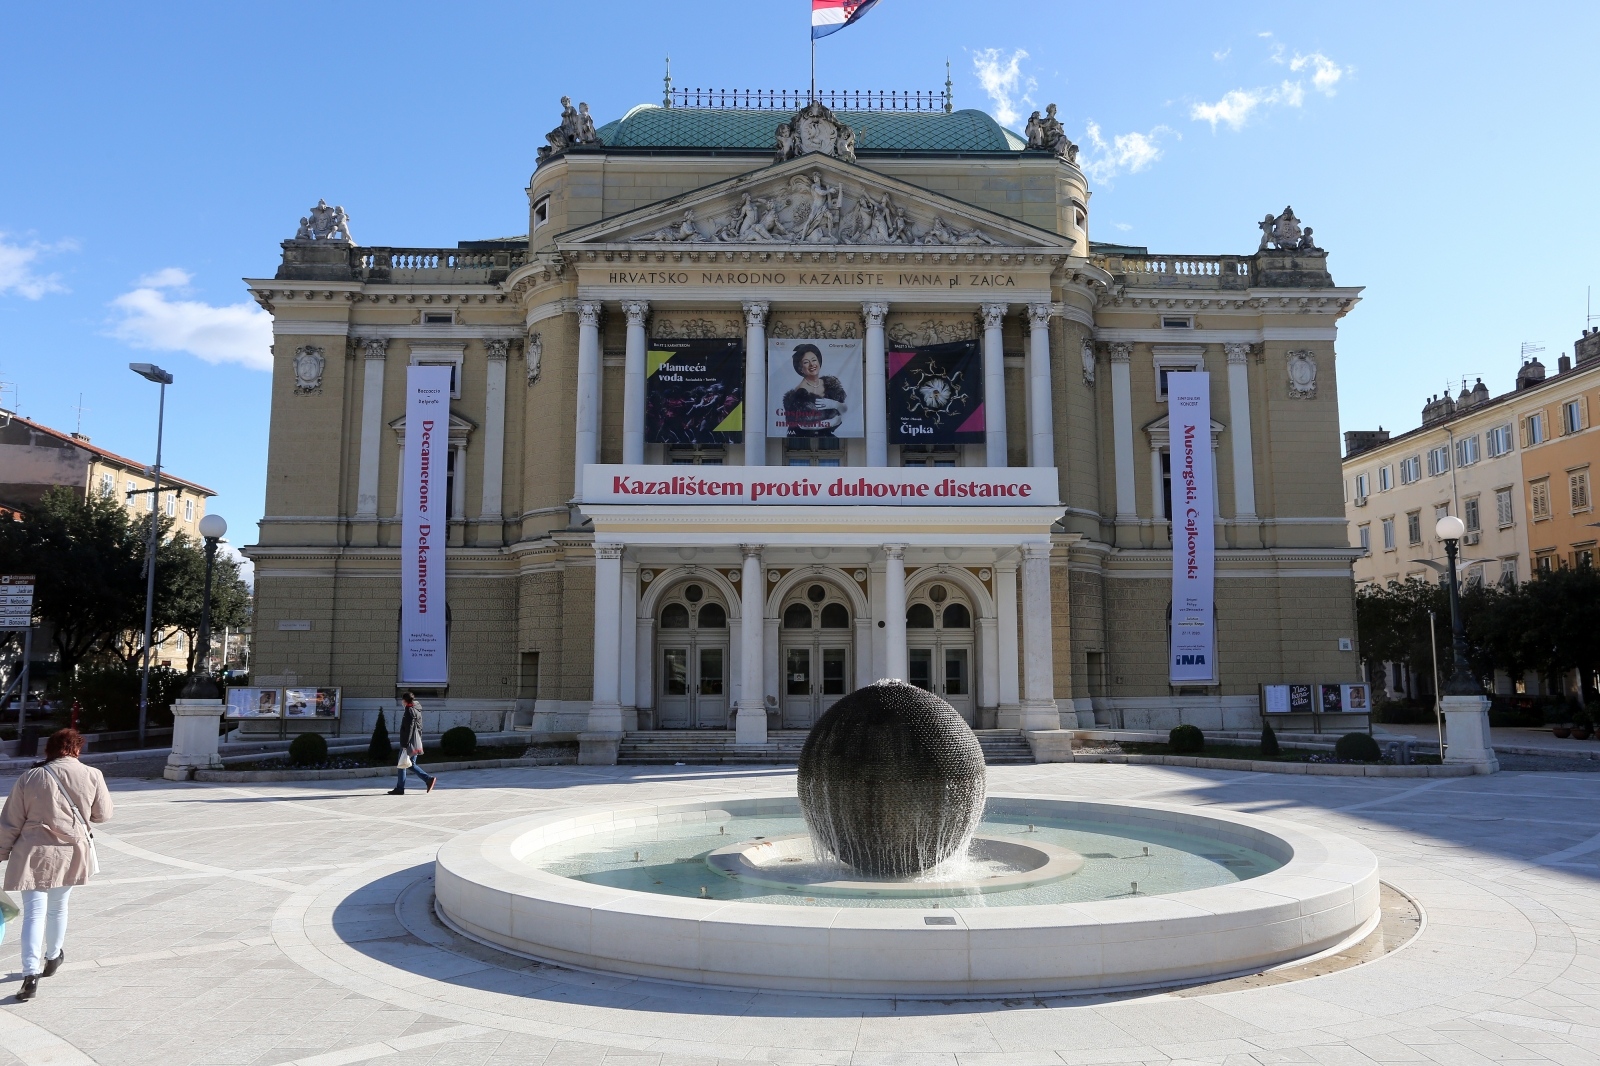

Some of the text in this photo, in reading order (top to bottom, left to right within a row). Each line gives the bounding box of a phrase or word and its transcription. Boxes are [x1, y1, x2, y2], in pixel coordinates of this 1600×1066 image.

[608, 272, 689, 284] HRVATSKO
[701, 272, 786, 285] NARODNO
[799, 271, 884, 285] KAZALIŠTE
[899, 274, 943, 286] IVANA
[658, 363, 707, 372] Plamteća
[658, 373, 684, 382] voda
[900, 421, 934, 437] Čipka
[419, 420, 434, 513] Decamerone
[1182, 424, 1198, 505] Musorgski,
[612, 475, 1033, 502] Kazalištem protiv duhovne distance
[1184, 507, 1200, 580] Čajkovski
[418, 524, 431, 615] Dekameron
